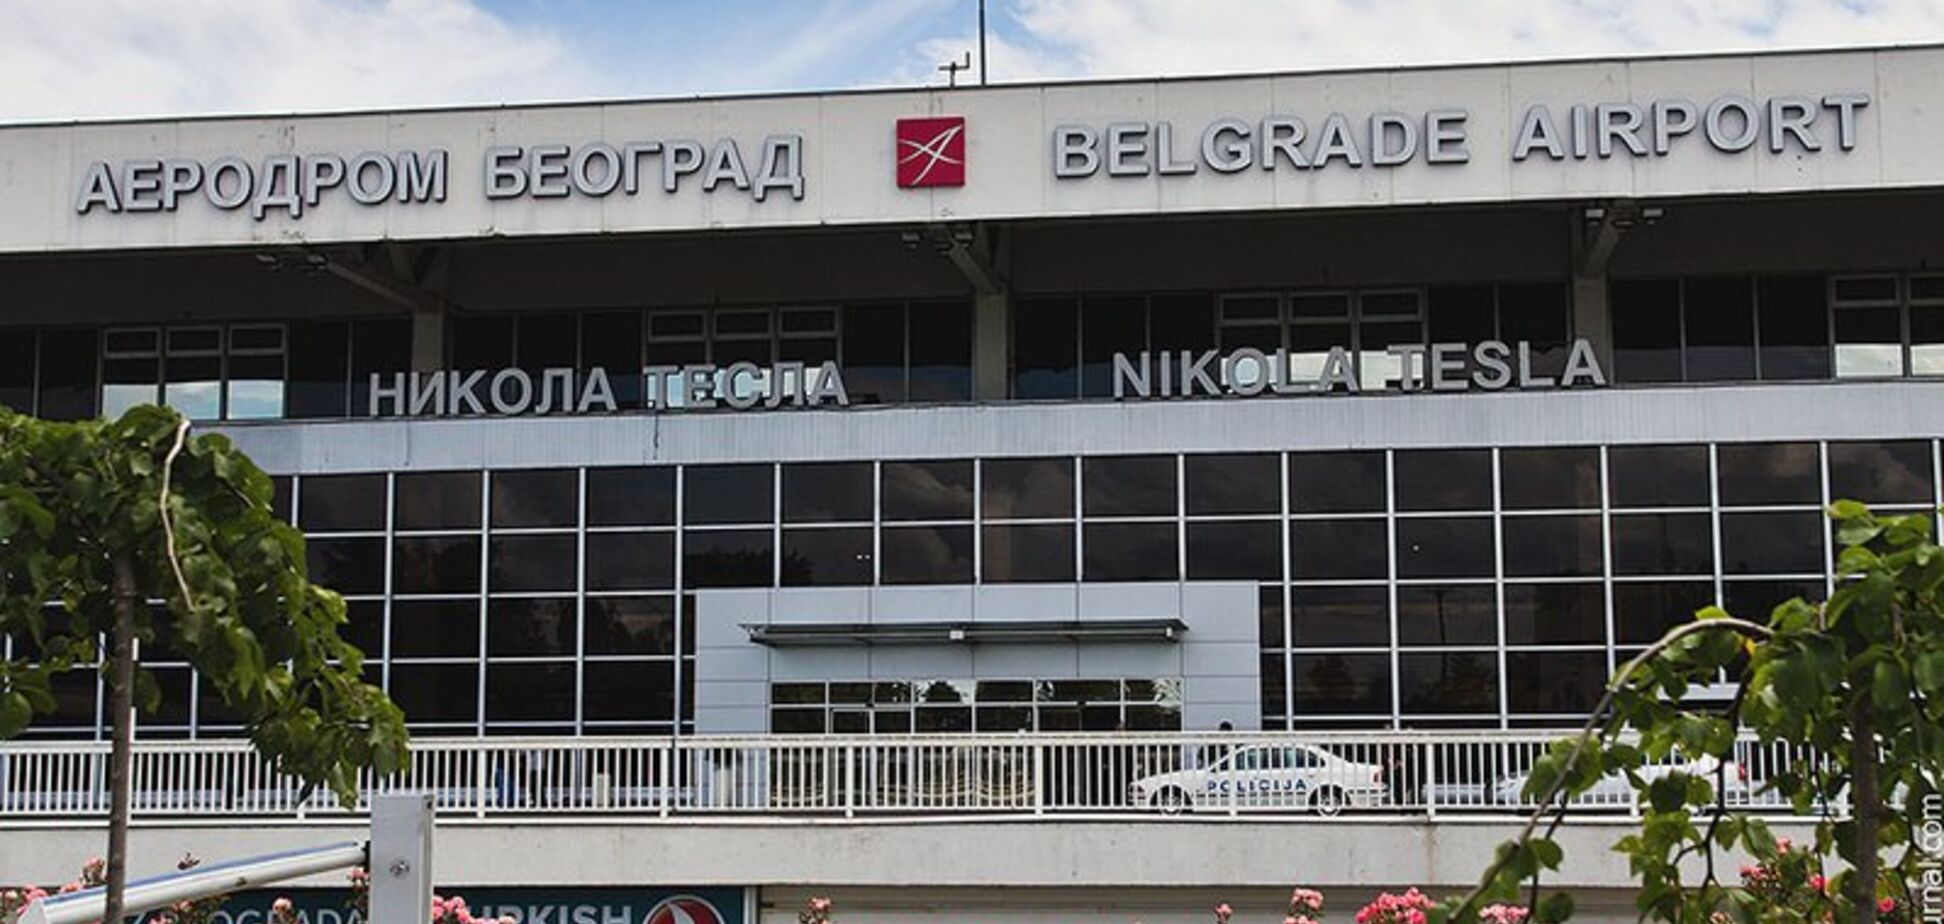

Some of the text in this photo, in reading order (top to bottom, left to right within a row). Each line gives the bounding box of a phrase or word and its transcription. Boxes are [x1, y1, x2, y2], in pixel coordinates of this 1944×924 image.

[1053, 92, 1870, 179] BELGRADE AIRPORT
[76, 135, 804, 220] АЕРОДРОМ БЕОГРАД
[369, 359, 850, 417] НИКОЛА ТЕСЛА
[1112, 337, 1606, 400] NIKOLA TESLA
